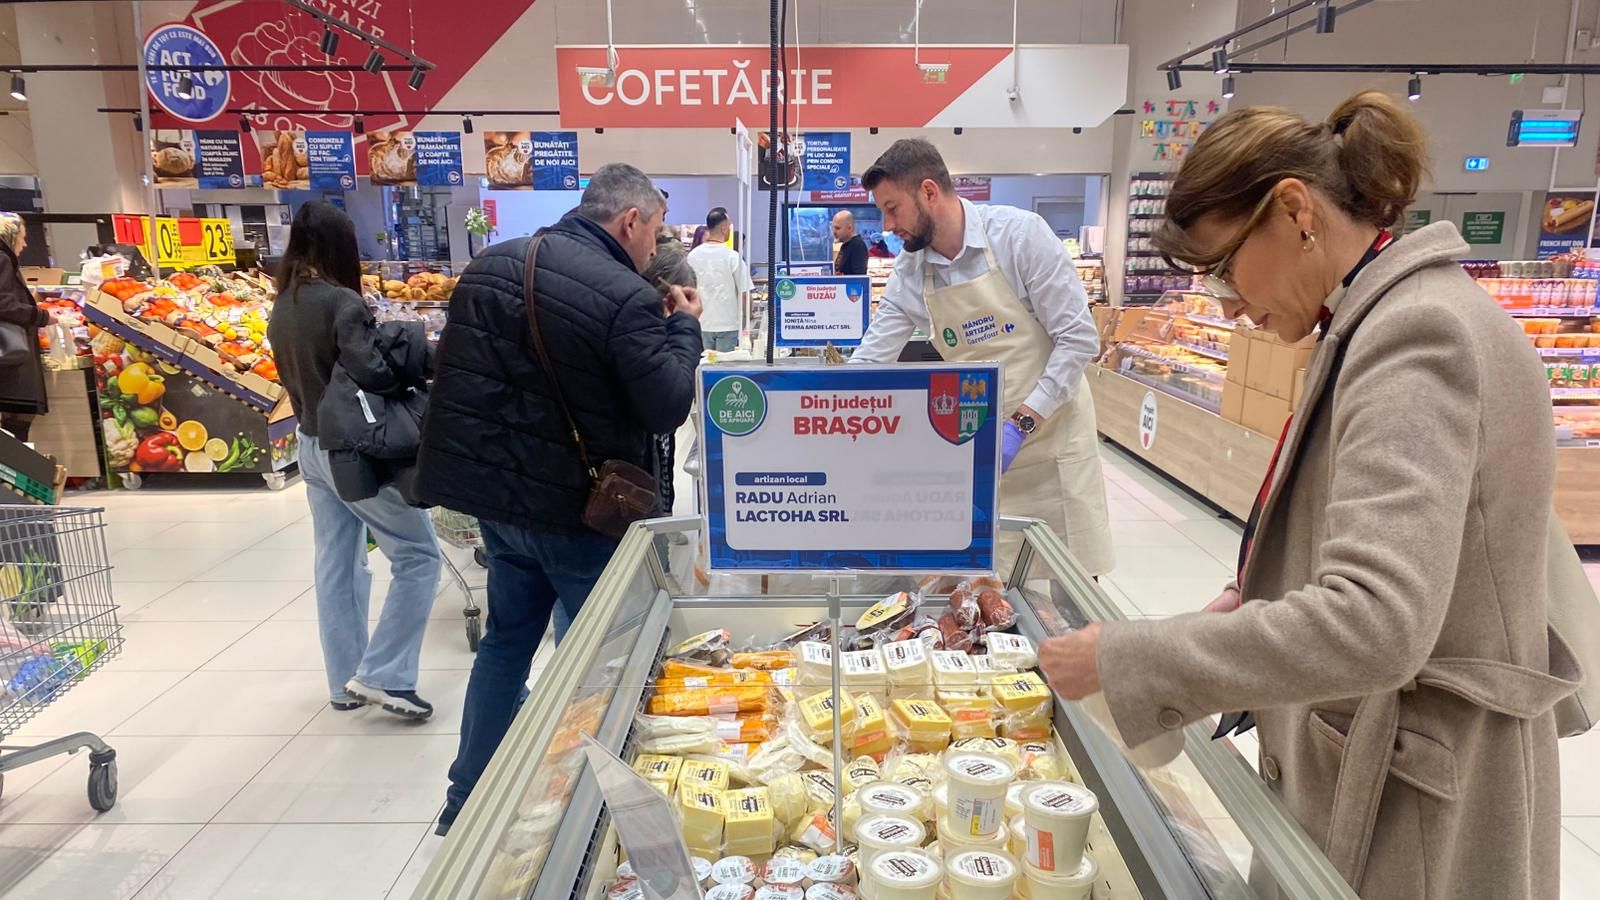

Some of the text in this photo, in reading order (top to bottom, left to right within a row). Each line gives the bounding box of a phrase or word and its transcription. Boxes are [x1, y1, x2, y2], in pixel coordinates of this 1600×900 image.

[160, 49, 192, 67] ACT
[581, 59, 833, 106] COFETĂRIE
[163, 82, 207, 100] FOD
[205, 224, 228, 258] 23
[807, 291, 837, 300] BUZĂU
[962, 314, 995, 330] MÂNDRU
[964, 322, 997, 338] ARTIZAN
[966, 330, 1000, 346] Carrefour
[800, 394, 893, 414] Din județul
[719, 409, 755, 418] DE AICI
[793, 415, 901, 442] BRAȘOV
[753, 475, 808, 484] artizan local
[735, 491, 837, 504] RADU Adrian
[736, 510, 849, 522] LACTOHA SRL
